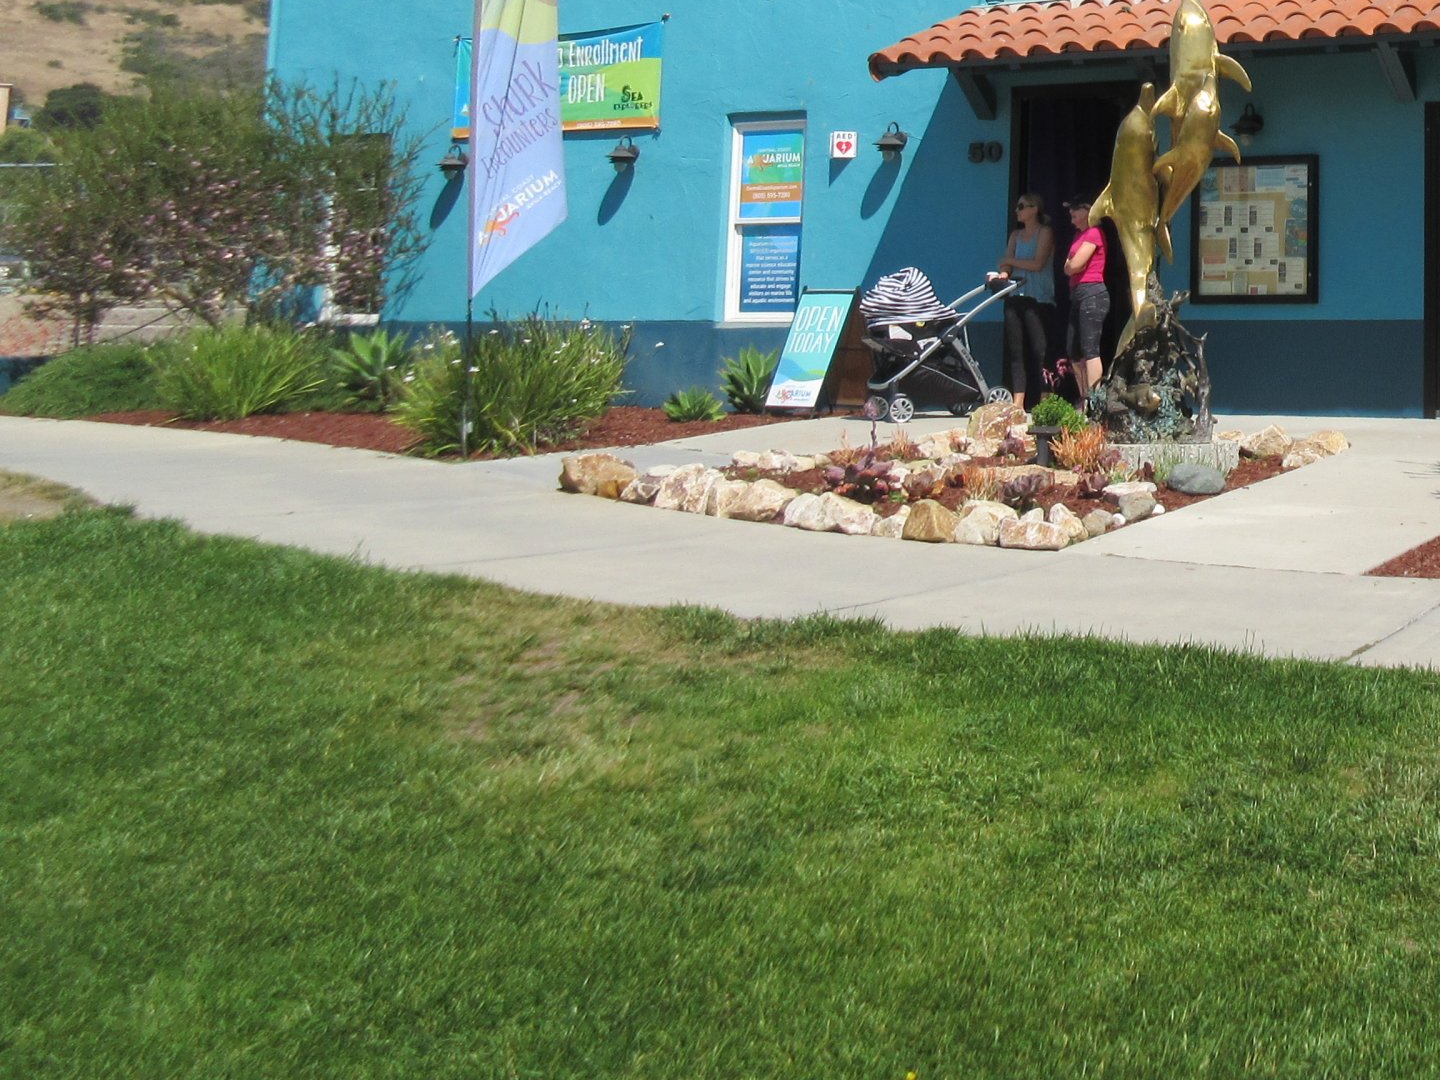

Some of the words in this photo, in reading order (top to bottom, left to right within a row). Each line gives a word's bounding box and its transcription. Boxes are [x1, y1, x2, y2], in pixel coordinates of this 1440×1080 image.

[568, 73, 606, 104] OPEN
[795, 306, 844, 332] OPEN
[788, 332, 836, 353] TODAY
